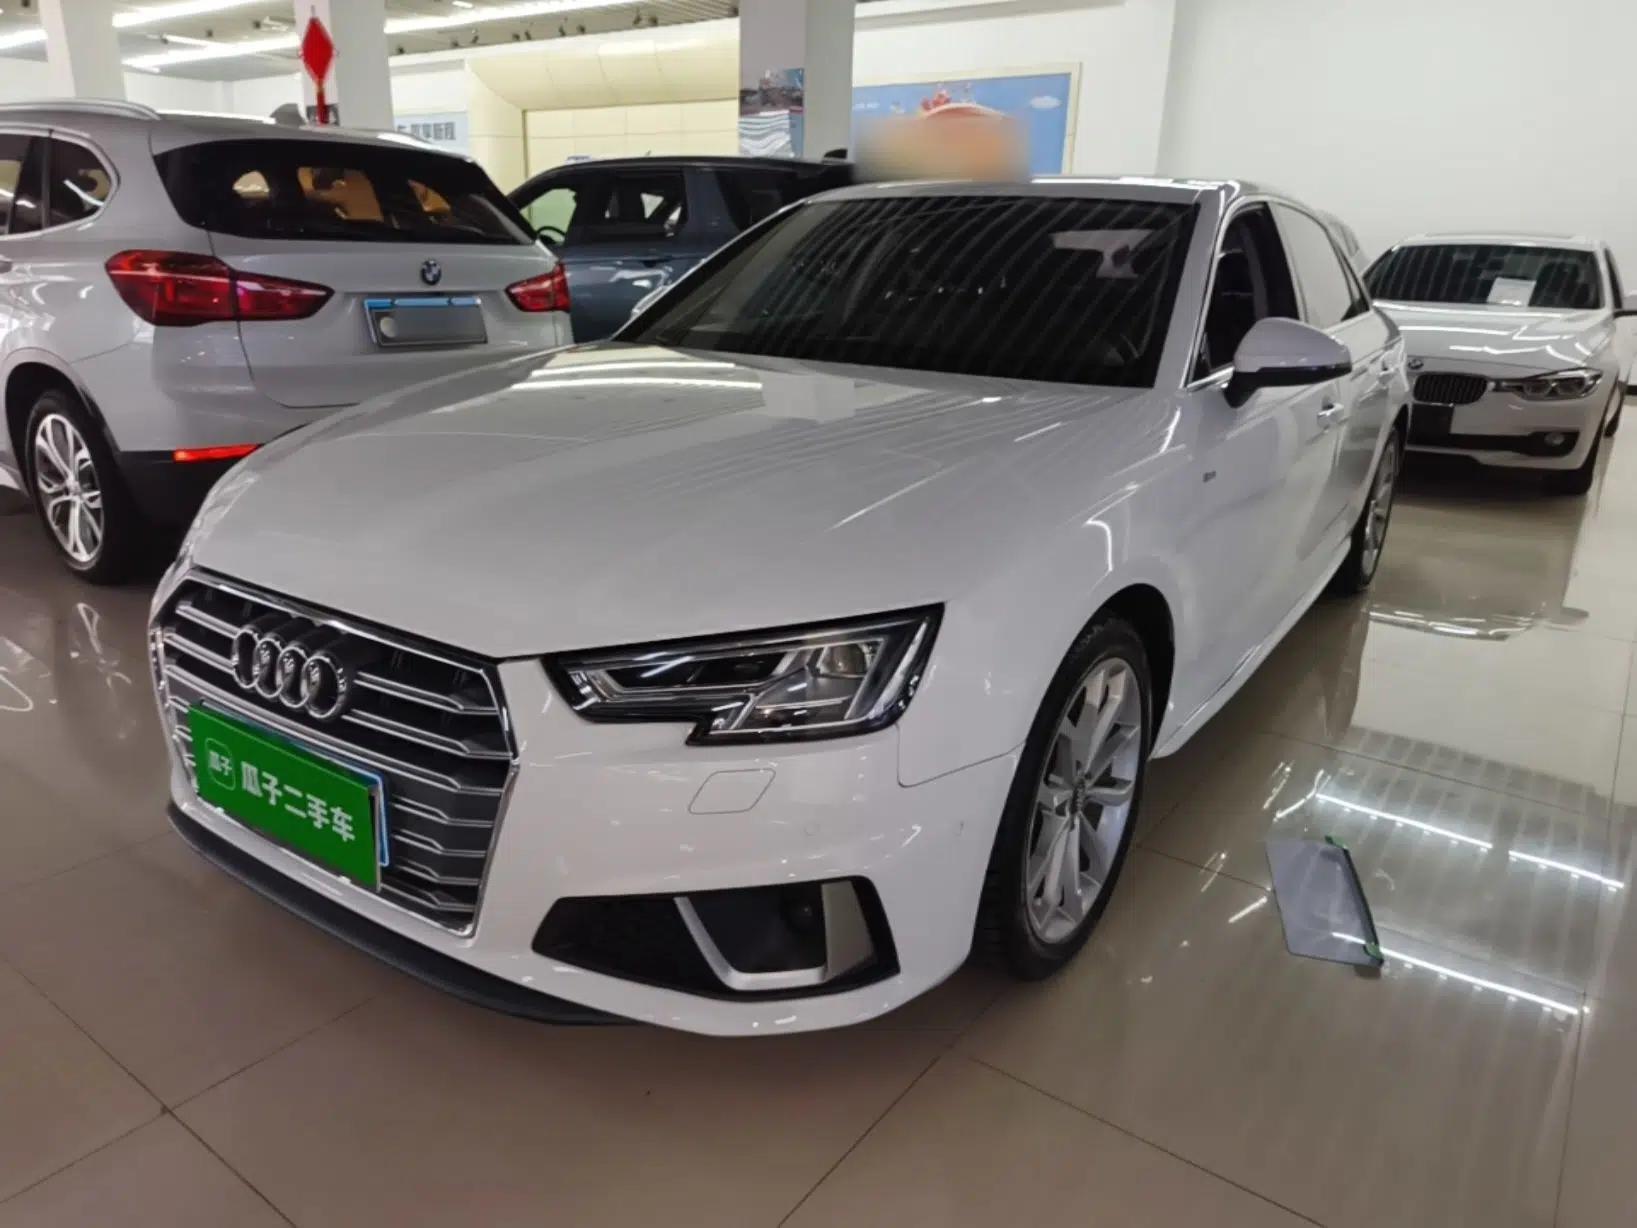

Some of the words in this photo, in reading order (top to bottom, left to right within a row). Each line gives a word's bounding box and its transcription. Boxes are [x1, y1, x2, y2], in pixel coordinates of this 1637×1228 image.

[241, 761, 356, 842] 瓜子二手车
